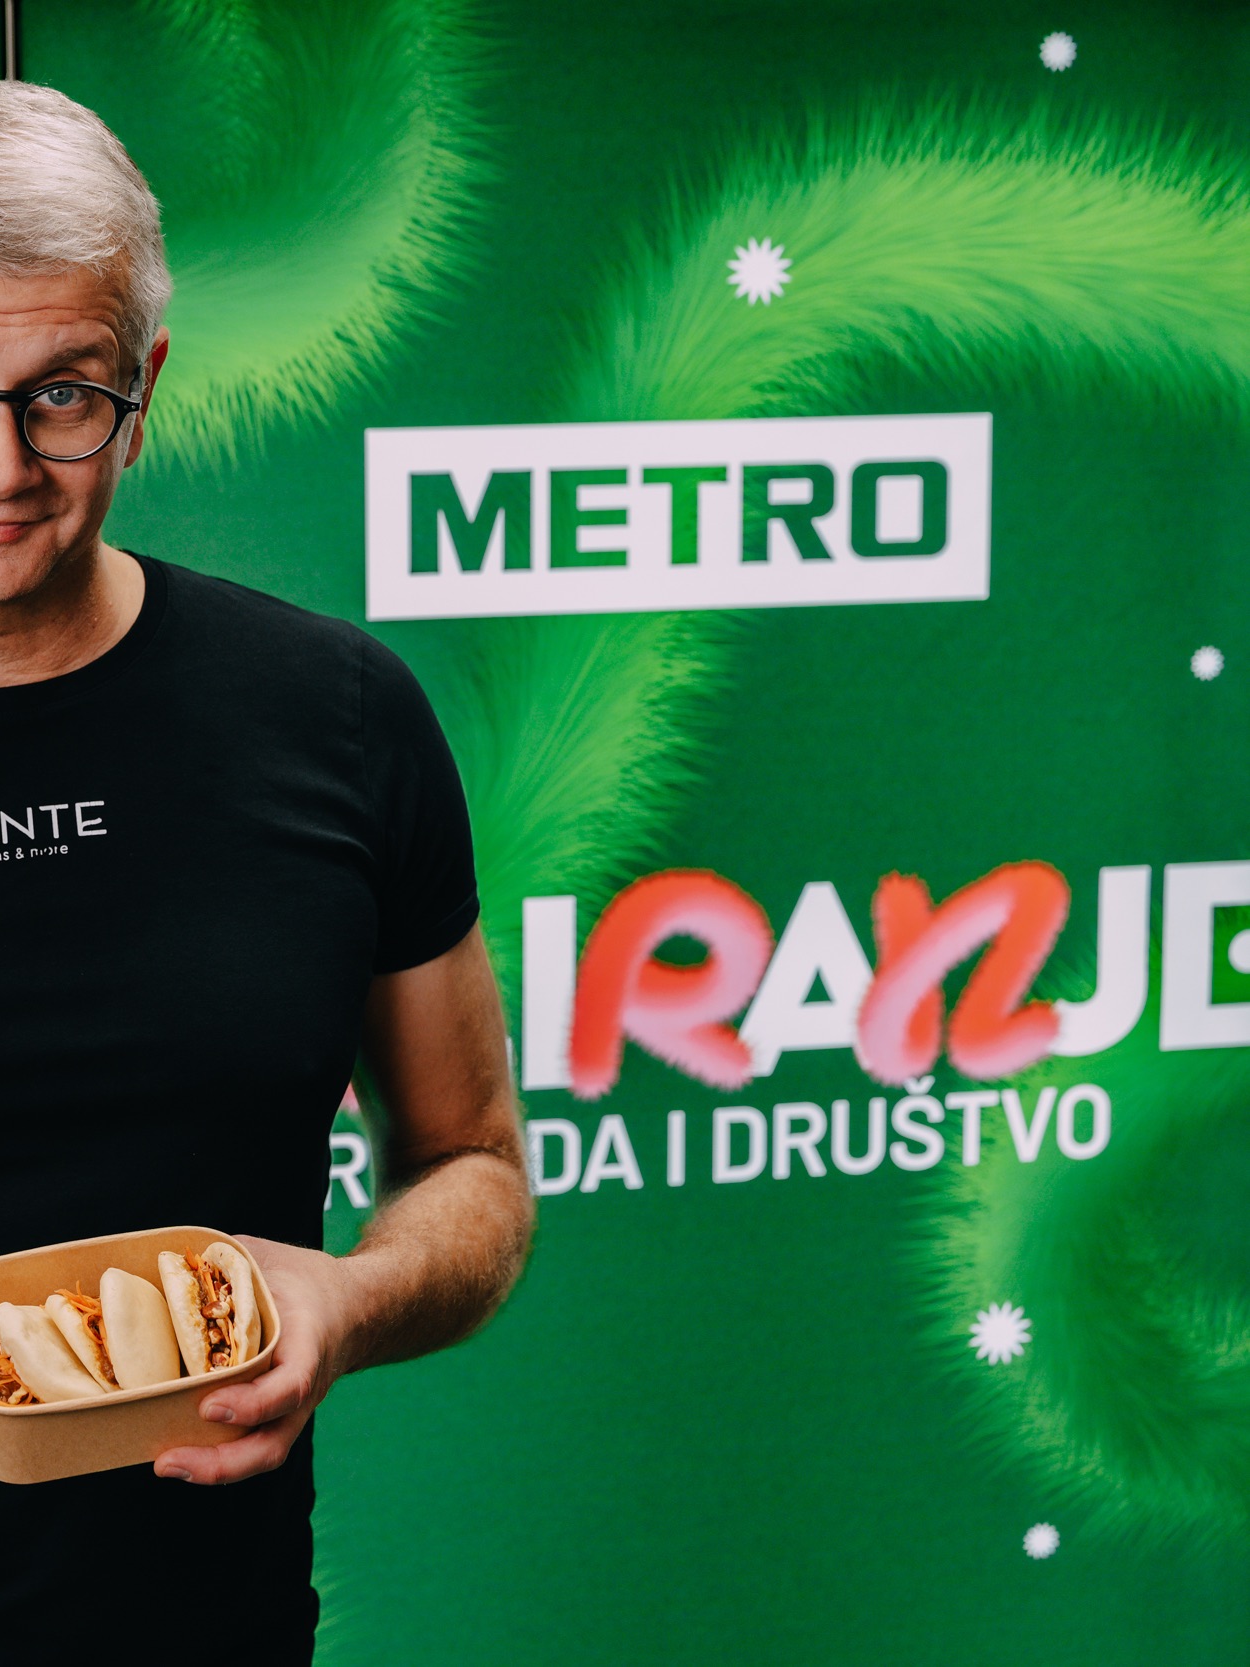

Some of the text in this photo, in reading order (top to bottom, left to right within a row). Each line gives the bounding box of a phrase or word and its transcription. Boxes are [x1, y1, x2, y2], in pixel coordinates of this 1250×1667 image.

[408, 460, 950, 576] METRO
[15, 847, 25, 860] &
[667, 1110, 687, 1188] I
[712, 1075, 1112, 1185] DRUŠTVO
